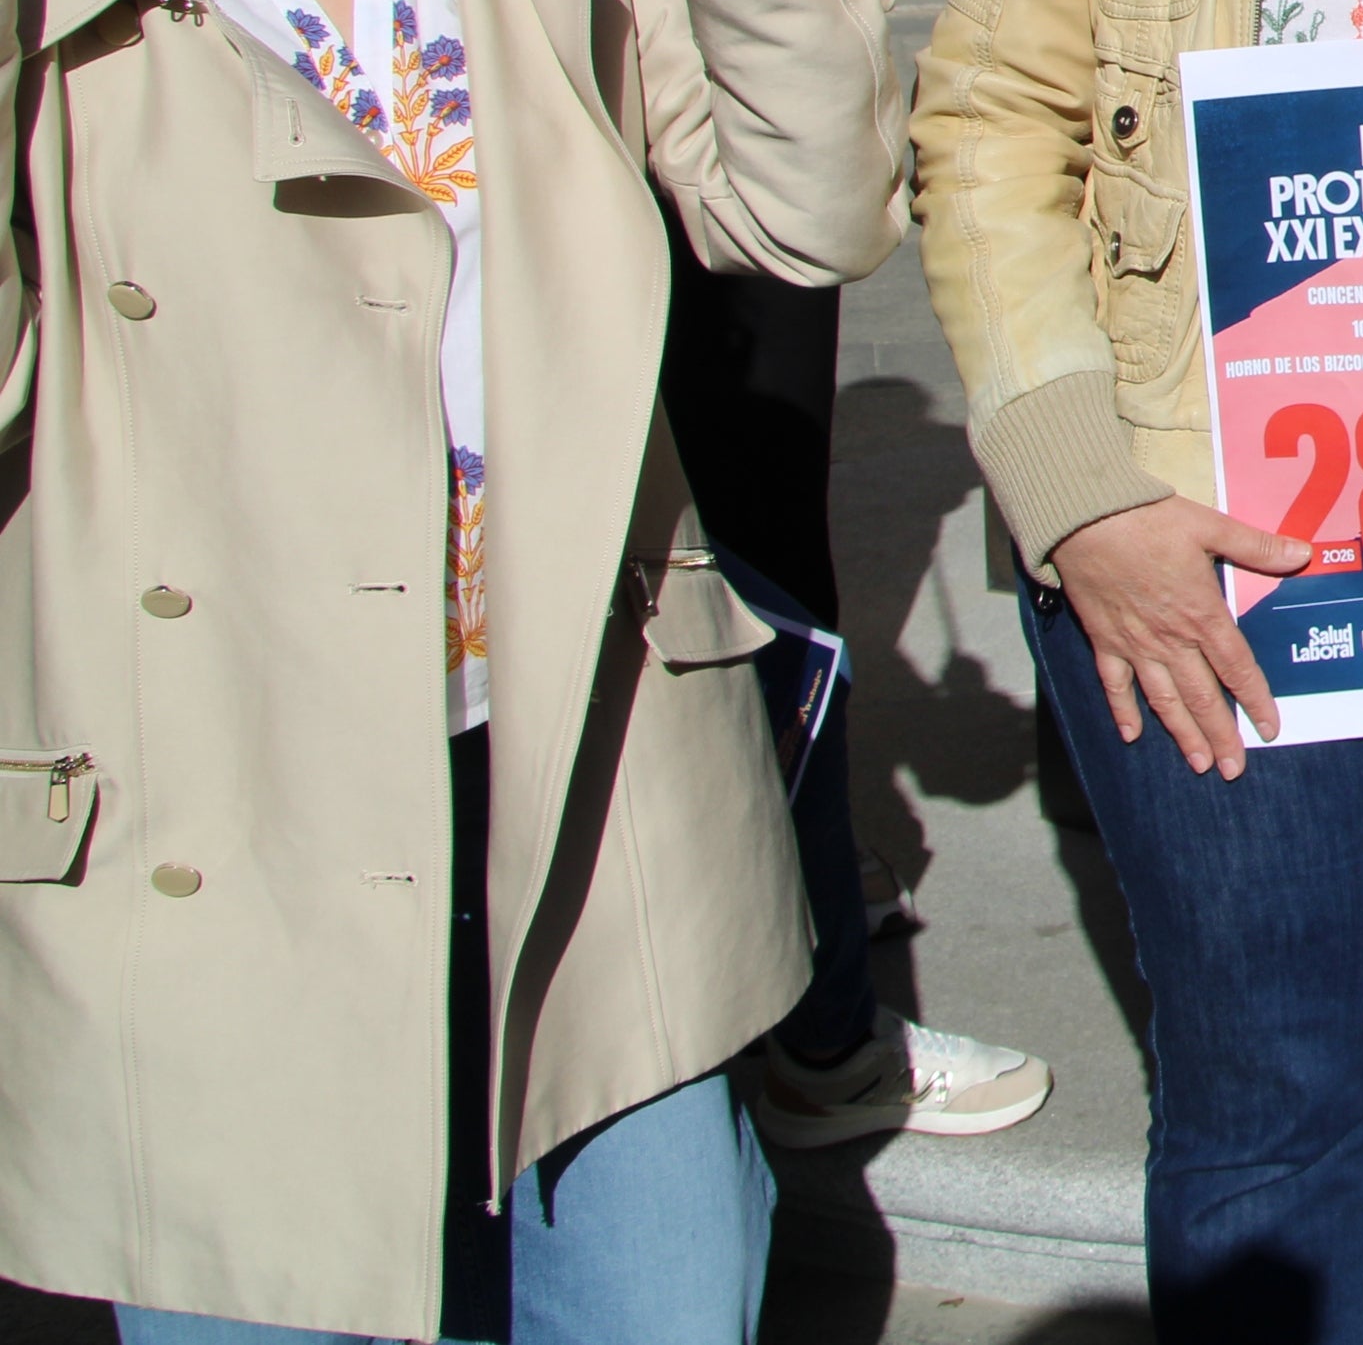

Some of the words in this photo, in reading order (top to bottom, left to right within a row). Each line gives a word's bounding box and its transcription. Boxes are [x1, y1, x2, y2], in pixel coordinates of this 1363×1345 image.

[1264, 217, 1327, 263] XXI
[1225, 359, 1272, 379] HORNO
[1275, 357, 1293, 374] DE
[1296, 356, 1321, 373] LOS
[1322, 548, 1355, 564] 2026
[1308, 624, 1353, 645] Salud
[1291, 641, 1354, 663] Laboral
